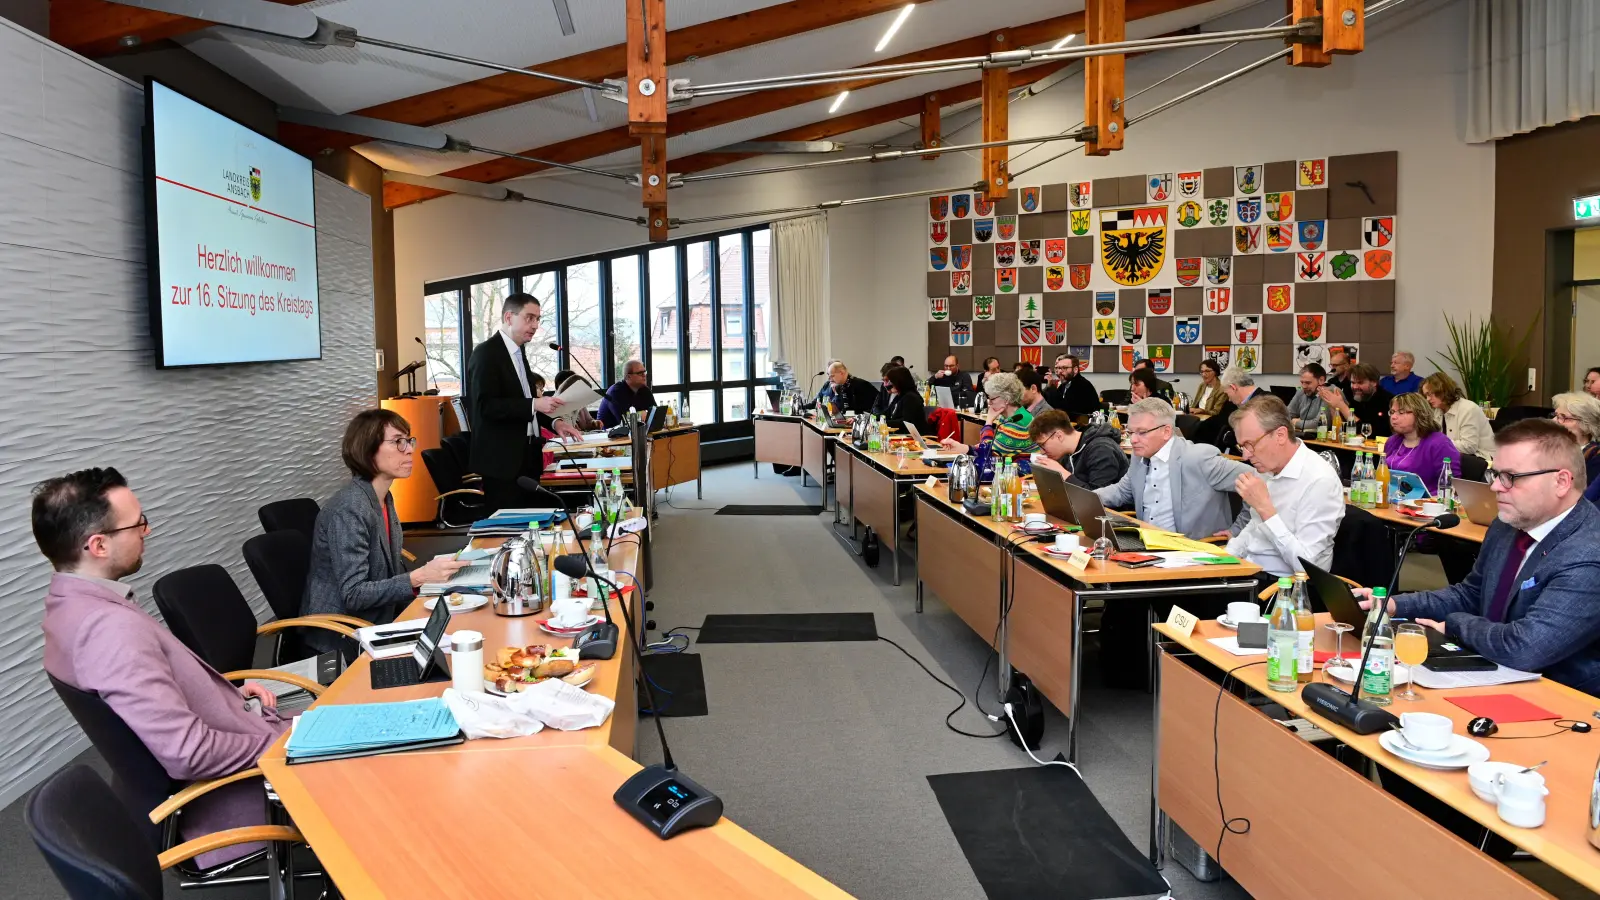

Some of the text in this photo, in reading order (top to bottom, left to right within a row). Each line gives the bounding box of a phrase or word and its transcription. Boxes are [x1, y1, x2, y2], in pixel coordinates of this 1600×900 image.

[222, 168, 250, 188] LANDKREIS
[227, 182, 250, 199] ANSBACH
[197, 243, 297, 282] Herzlich willkommen
[171, 282, 314, 319] zur 16. Sitzung des Kreistags
[1174, 613, 1190, 628] CSU
